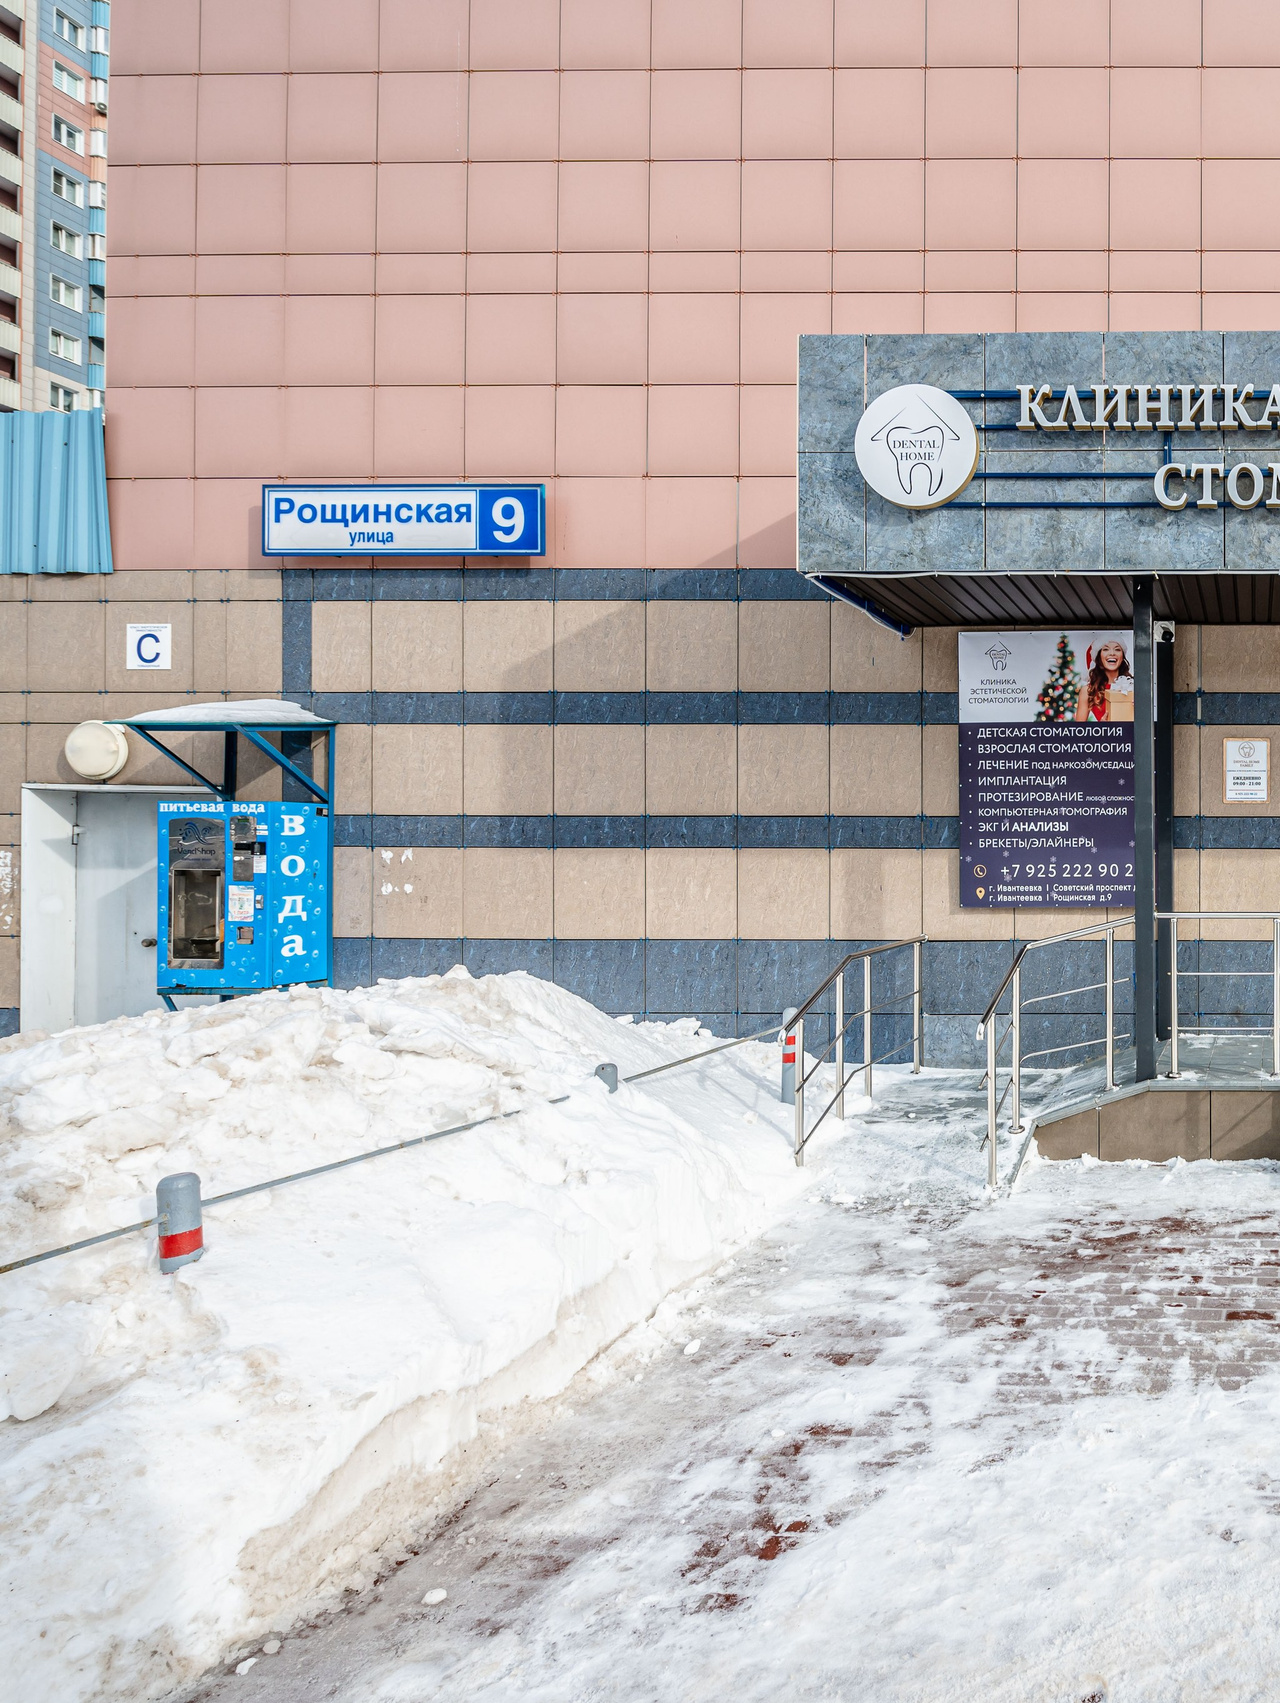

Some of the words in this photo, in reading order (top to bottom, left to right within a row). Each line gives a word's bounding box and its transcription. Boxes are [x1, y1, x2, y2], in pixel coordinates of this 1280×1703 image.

[893, 440, 940, 449] DENTAL
[900, 452, 935, 461] HOME
[274, 497, 472, 528] Рощинская
[491, 496, 525, 544] 9
[349, 531, 394, 547] улица
[970, 687, 1027, 695] ЭСТЕТИЧЕСКОЙ
[977, 728, 1027, 739] ДЕТСКАЯ
[1029, 727, 1123, 737] СТОМАТОЛОГИЯ
[978, 744, 1036, 754] ВЗРОСЛАЯ
[1038, 743, 1132, 753] СТОМАТОЛОГИЯ
[978, 760, 1029, 770] ЛЕЧЕНИЕ
[1031, 761, 1051, 770] ПОД
[978, 776, 1067, 787] ИМПЛАНТАЦИЯ
[978, 792, 1084, 802] ПРОТЕЗИРОВАНИЕ
[159, 802, 225, 813] питьевая
[232, 803, 265, 815] вода
[978, 808, 1058, 817] КОМПЬЮТЕРНАЯ
[1061, 807, 1128, 816] ТОМОГРАФИЯ
[978, 822, 998, 832] ЭКГ
[1001, 822, 1010, 832] И
[1012, 822, 1069, 832] АНАЛИЗЫ
[978, 837, 1094, 850] БРЕКЕТЫ/ЭЛАЙНЕРЫ
[1000, 864, 1021, 878] +7
[1025, 863, 1057, 878] 925
[1062, 863, 1093, 878] 222
[1098, 863, 1119, 878] 90
[277, 814, 308, 957] вода
[997, 884, 1042, 892] Ивантеевка
[1053, 883, 1093, 892] Советский
[1095, 885, 1131, 894] проспект
[997, 894, 1042, 902] Ивантеевка
[1053, 893, 1096, 902] Рощинская
[1099, 894, 1112, 902] д.9
